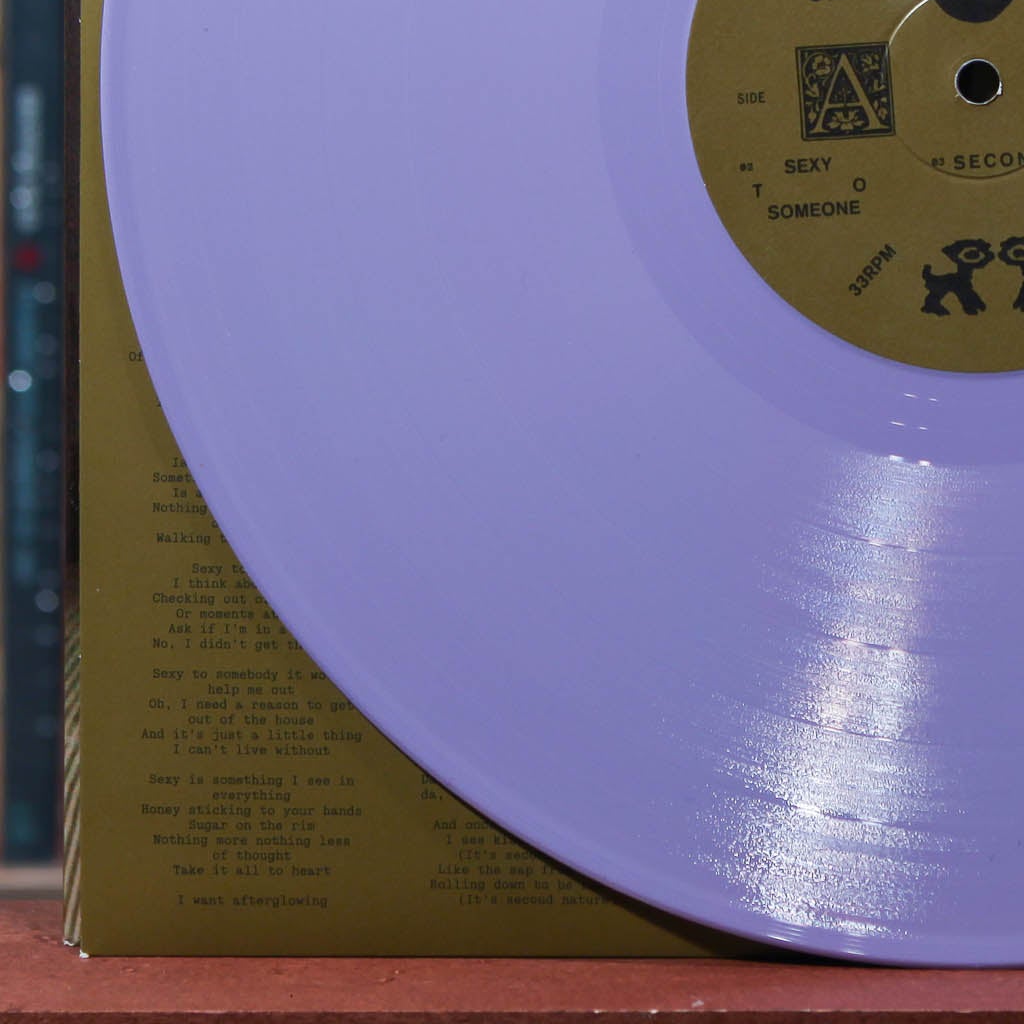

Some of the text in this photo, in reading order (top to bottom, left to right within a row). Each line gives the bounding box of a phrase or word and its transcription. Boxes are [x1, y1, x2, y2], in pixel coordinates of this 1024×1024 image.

[737, 91, 766, 105] SIDE
[784, 157, 832, 174] SEXY
[767, 200, 861, 220] SOMEONE
[848, 242, 897, 297] 33RPM
[208, 684, 295, 698] help me out
[188, 714, 314, 725] out of the house
[188, 819, 315, 833] Sugar on the rim
[175, 894, 329, 908] I want afterglowing
